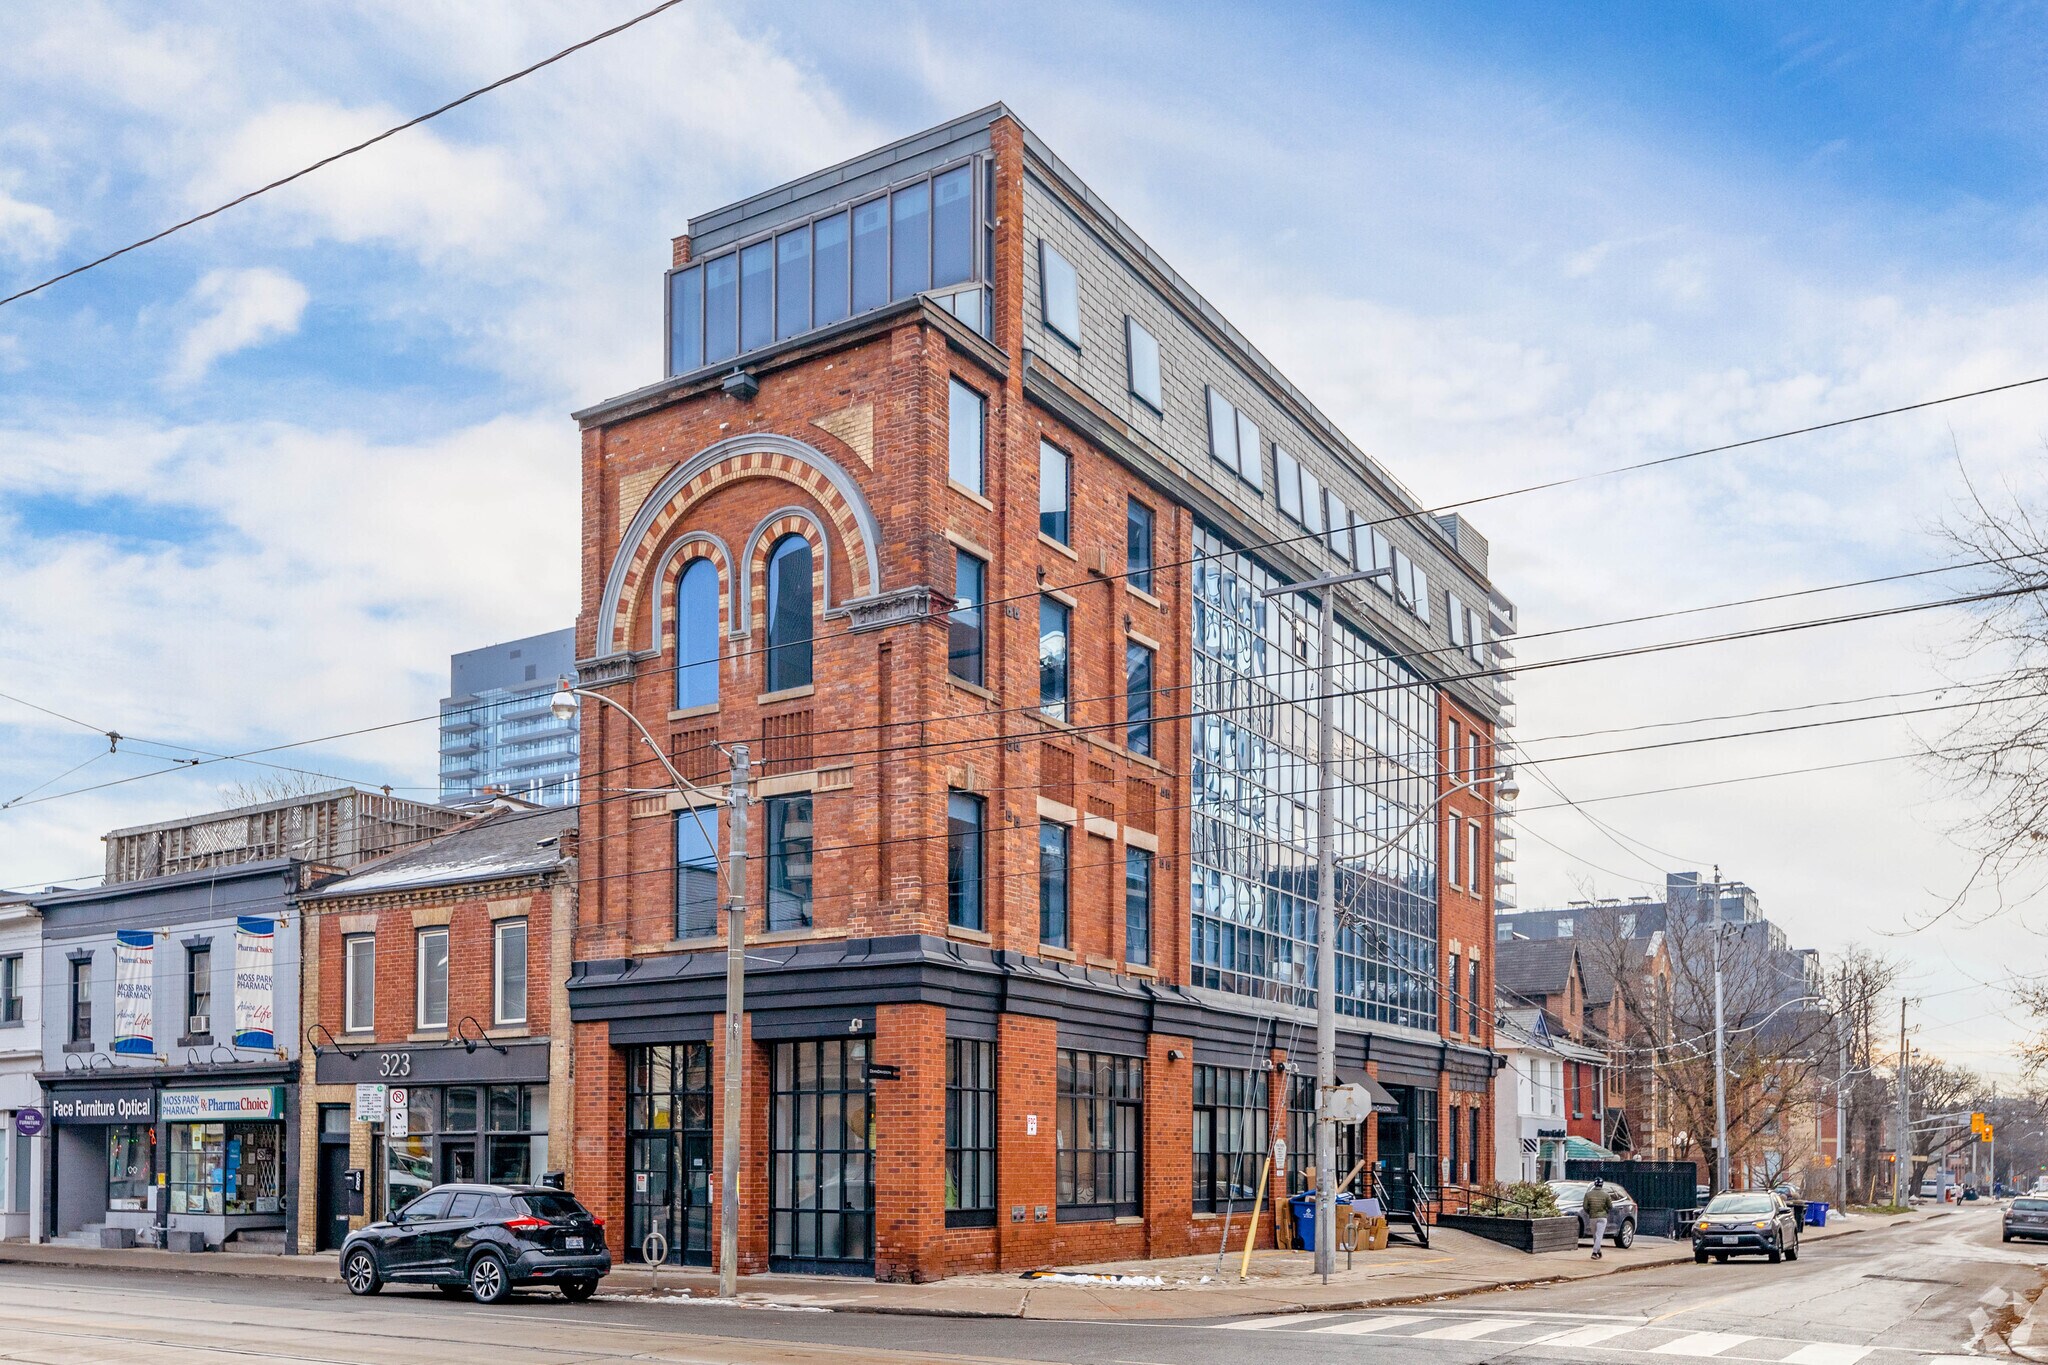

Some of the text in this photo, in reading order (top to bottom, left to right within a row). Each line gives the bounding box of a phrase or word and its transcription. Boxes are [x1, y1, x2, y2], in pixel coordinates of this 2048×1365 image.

[237, 944, 273, 953] PharmaChoice
[237, 973, 273, 983] MOSS PARK
[118, 983, 152, 993] MOSS PARK
[236, 981, 273, 991] PHARMACY
[117, 991, 152, 1000] PHARMACY
[379, 1052, 411, 1077] 323
[162, 1095, 200, 1105] MOSS PARK
[208, 1097, 269, 1111] PharmaChoice
[53, 1098, 151, 1119] Face Furniture Optical
[162, 1105, 200, 1115] PHARMACY
